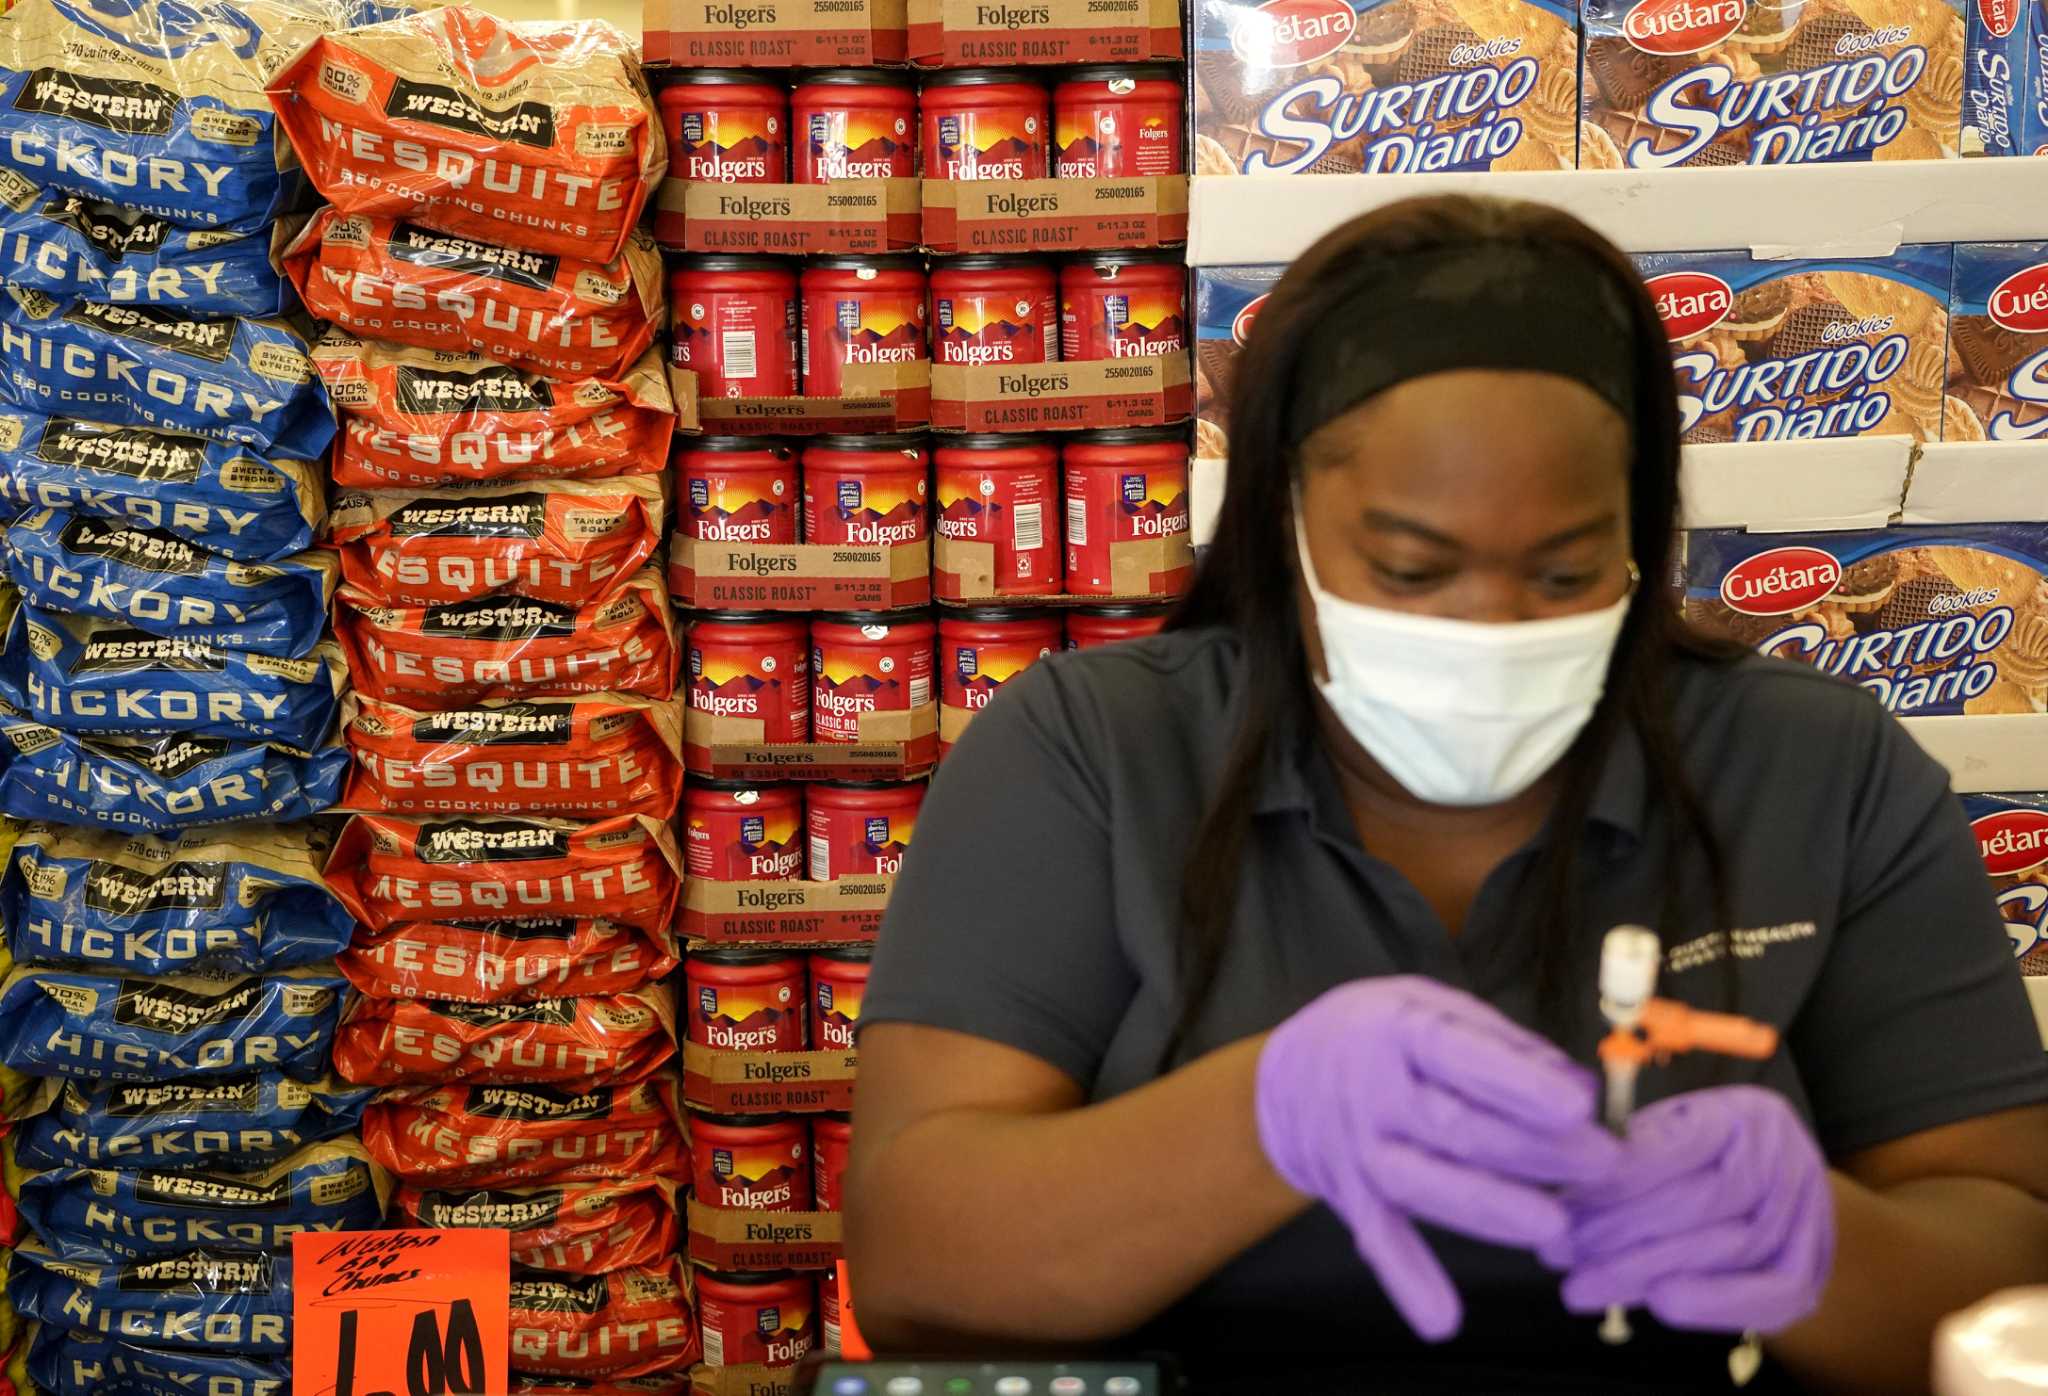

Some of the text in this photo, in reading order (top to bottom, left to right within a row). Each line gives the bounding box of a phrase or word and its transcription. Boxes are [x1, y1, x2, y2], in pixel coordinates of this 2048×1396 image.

[705, 5, 776, 29] Folgers
[814, 1, 864, 13] 2550020165
[977, 5, 1049, 30] Folgers
[1088, 1, 1139, 13] 2550020165
[1627, 0, 1741, 40] Cuétara
[690, 40, 792, 57] CLASSIC ROAST
[961, 41, 1065, 58] CLASSIC ROAST
[1449, 36, 1522, 66] Cookies
[1834, 25, 1911, 55] Cookies
[35, 81, 162, 120] WESTERN
[1628, 45, 1928, 168] SURTIDO
[407, 93, 541, 135] WESTERN
[1243, 56, 1539, 175] SURTIDO
[1971, 89, 1991, 143] Diario
[1139, 129, 1168, 139] Folgers
[1365, 110, 1523, 174] Diario
[1744, 98, 1908, 166] Diario
[320, 116, 625, 212] MESQUITE
[689, 156, 765, 184] Folgers
[816, 157, 892, 179] Folgers
[947, 159, 1023, 180] Folgers
[828, 196, 877, 207] 2550020165
[987, 193, 1058, 217] Folgers
[1095, 187, 1144, 199] 2550020165
[385, 182, 485, 213] COOKING
[493, 209, 589, 237] CHUNKS
[720, 196, 791, 220] Folgers
[704, 231, 805, 247] CLASSIC ROAST
[972, 227, 1074, 245] CLASSIC ROAST
[0, 227, 226, 301] ICKORY
[408, 231, 544, 275] WESTERN
[320, 265, 619, 349] MESQUITE
[85, 301, 223, 346] WESTERN
[1821, 314, 1895, 344] Cookies
[332, 339, 363, 348] USA
[845, 343, 916, 365] Folgers
[944, 341, 1014, 366] Folgers
[1114, 337, 1180, 359] Folgers
[2, 321, 283, 424] HICKORY
[1104, 367, 1153, 379] 2550020165
[413, 379, 530, 399] WESTERN
[999, 374, 1068, 397] Folgers
[60, 389, 156, 422] COOKING
[735, 404, 805, 417] Folgers
[985, 405, 1084, 424] CLASSIC ROAST
[1735, 385, 1891, 442] Diario
[57, 433, 196, 471] WESTERN
[230, 473, 276, 484] STRONG
[231, 466, 265, 475] SWEET
[349, 498, 373, 509] USA
[402, 504, 530, 525] WESTERN
[573, 516, 610, 526] TANGY
[697, 520, 770, 542] Folgers
[1132, 512, 1187, 537] Folgers
[847, 521, 916, 546] Folgers
[369, 546, 617, 593] ESQUITE
[728, 553, 797, 576] Folgers
[833, 552, 881, 563] 2550020165
[713, 586, 811, 601] CLASSIC ROAST
[1724, 562, 1837, 602] Cuétara
[1928, 587, 1999, 614] Cookies
[439, 607, 563, 628] WESTERN
[84, 639, 211, 660] WESTERN
[367, 636, 653, 685] MESQUITE
[27, 672, 288, 721] HICKORY
[693, 688, 757, 716] Folgers
[815, 686, 875, 716] Folgers
[431, 712, 557, 733] WESTERN
[744, 752, 815, 765] Folgers
[356, 750, 644, 793] MESQUITE
[424, 800, 521, 811] COOKING
[431, 830, 556, 851] WESTERN
[751, 850, 803, 875] Folgers
[100, 876, 216, 904] WESTERN
[372, 861, 651, 909] MESQUITE
[840, 884, 886, 896] 2550020165
[737, 890, 805, 910] Folgers
[724, 919, 819, 936] CLASSIC ROAST
[133, 989, 250, 1025] WESTERN
[707, 1025, 777, 1050] Folgers
[744, 1061, 811, 1083] Folgers
[122, 1084, 246, 1106] WESTERN
[482, 1089, 599, 1115] WESTERN
[731, 1090, 825, 1107] CLASSIC ROAST
[151, 1174, 278, 1201] WESTERN
[721, 1186, 791, 1209] Folgers
[433, 1204, 549, 1225] WESTERN
[746, 1222, 812, 1244] Folgers
[137, 1260, 258, 1282] WESTERN
[62, 1287, 288, 1344] HICKOR
